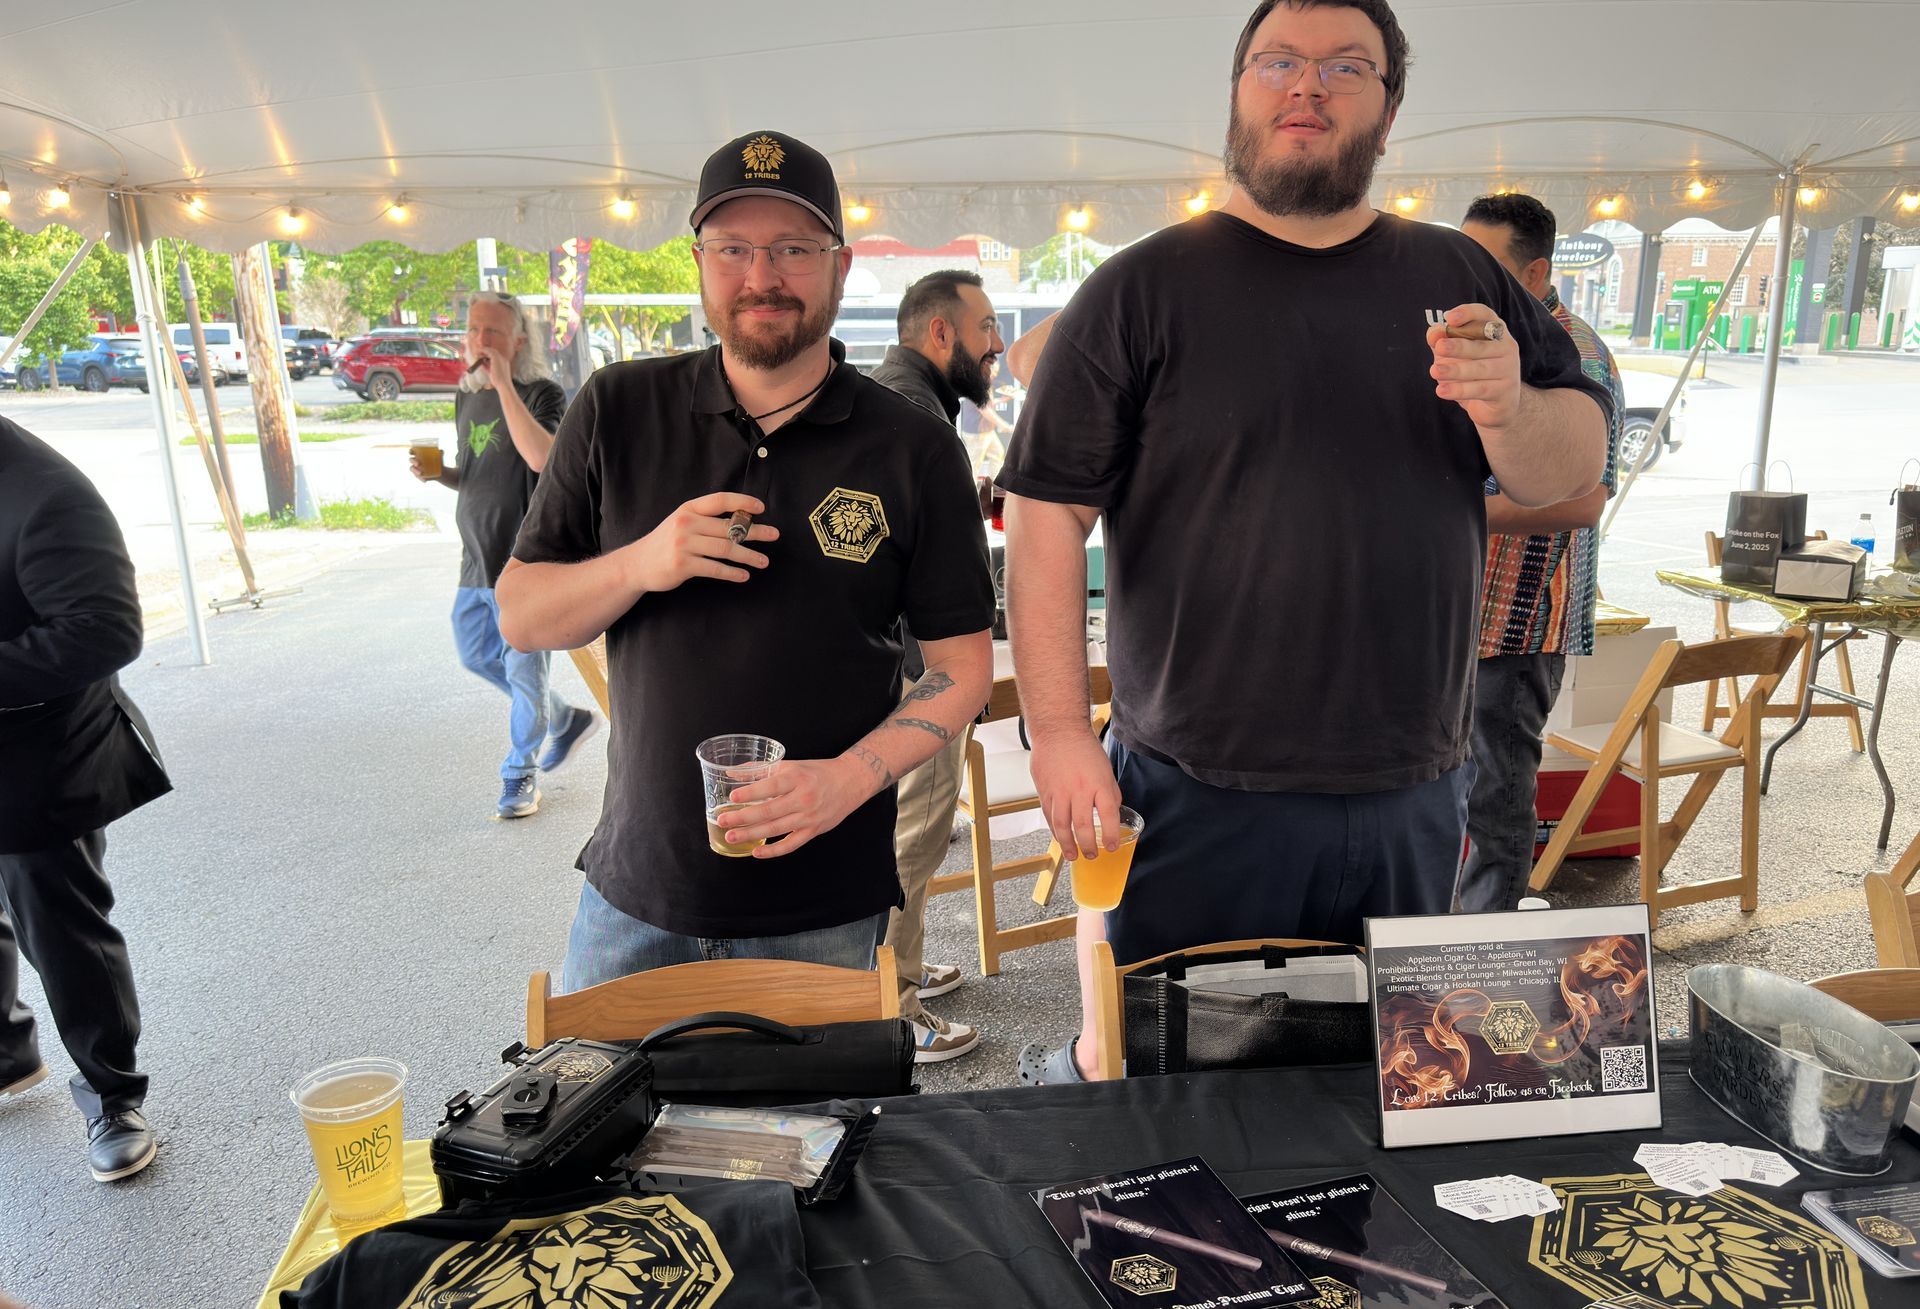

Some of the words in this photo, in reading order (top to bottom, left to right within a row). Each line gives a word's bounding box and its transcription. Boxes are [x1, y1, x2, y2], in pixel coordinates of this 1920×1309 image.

[754, 172, 780, 180] TRIBES
[1558, 240, 1604, 252] Anthony
[1702, 285, 1721, 295] ATM
[1765, 531, 1780, 539] Fox
[830, 540, 839, 548] 12
[840, 542, 864, 553] TRIBES
[1731, 541, 1744, 549] June
[1751, 543, 1770, 551] 2025
[1440, 944, 1476, 953] Currently
[1478, 943, 1494, 951] sold
[1408, 955, 1442, 965] Appleton
[1444, 953, 1464, 963] Cigar
[1466, 953, 1480, 961] Co.
[1487, 951, 1524, 961] Appleton,
[1377, 965, 1419, 975] Prohibition
[1420, 964, 1446, 973] Spirits
[1447, 963, 1454, 971] &
[1455, 962, 1476, 972] Cigar
[1477, 961, 1506, 971] Lounge
[1513, 959, 1537, 967] Green
[1538, 958, 1555, 967] Bay,
[1556, 957, 1568, 965] WI
[1390, 975, 1415, 983] Exotic
[1416, 973, 1442, 982] Blends
[1444, 972, 1464, 981] Cigar
[1466, 971, 1495, 980] Lounge
[1502, 968, 1544, 977] Milwaukee,
[1387, 984, 1420, 993] Ultimate
[1421, 983, 1442, 992] Cigar
[1443, 982, 1450, 990] &
[1452, 980, 1481, 989] Hookah
[1483, 979, 1511, 988] Lounge
[1518, 977, 1551, 986] Chicago,
[1389, 1087, 1421, 1106] Love
[1423, 1090, 1438, 1103] 12
[1484, 1082, 1518, 1104] Follow
[1520, 1087, 1533, 1097] us
[1535, 1087, 1548, 1095] on
[1547, 1077, 1595, 1099] Facebook
[335, 1124, 392, 1167] LION'S
[1077, 1185, 1102, 1196] cigar
[1102, 1177, 1137, 1190] doesn't
[1136, 1173, 1157, 1185] just
[1157, 1164, 1200, 1181] glisten-it
[1247, 1202, 1272, 1214] cigar
[1271, 1195, 1307, 1209] doesn't
[1305, 1191, 1327, 1203] just
[1327, 1182, 1370, 1199] glisten-it
